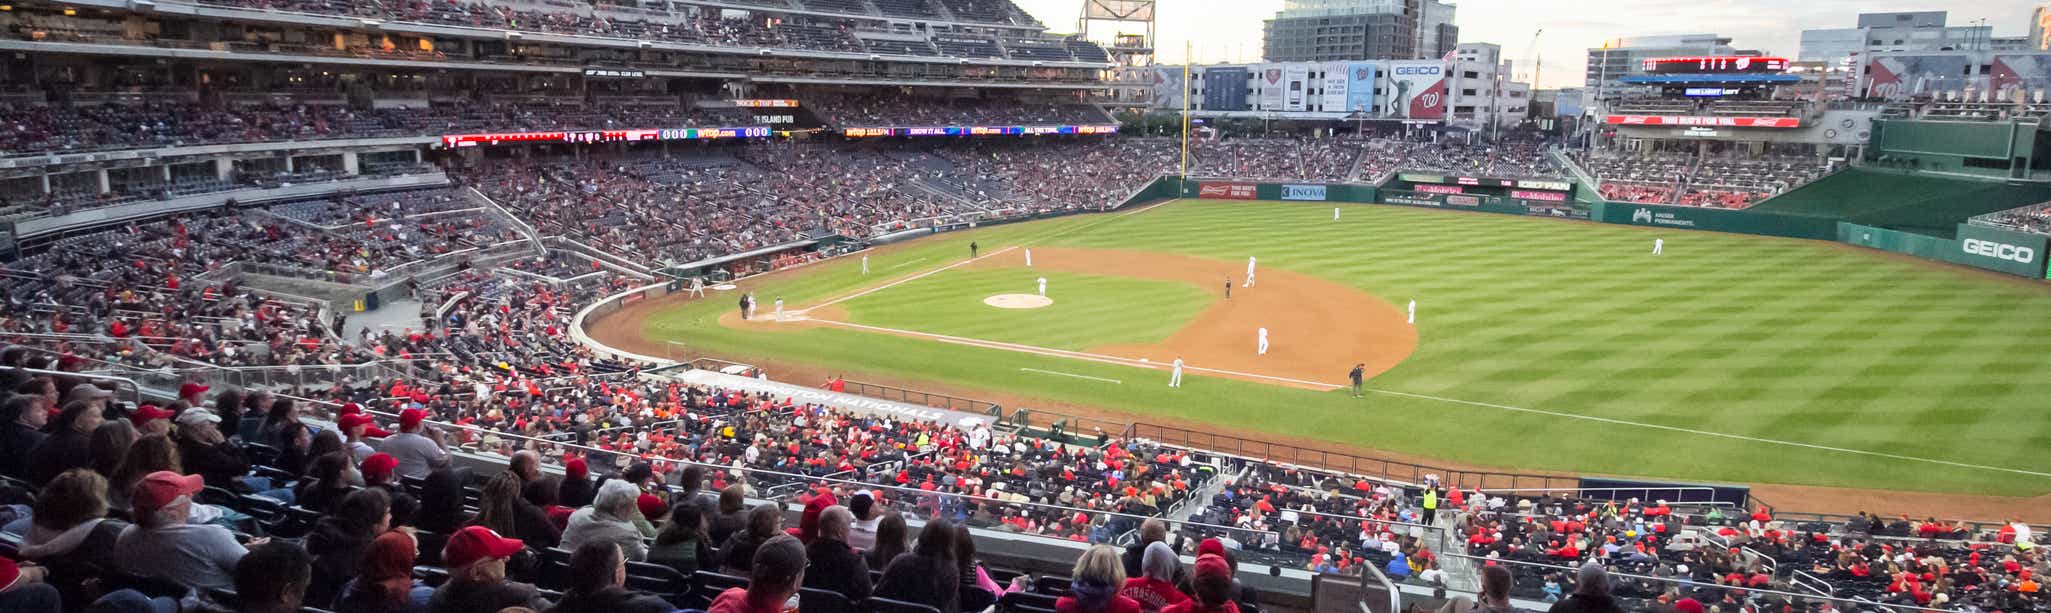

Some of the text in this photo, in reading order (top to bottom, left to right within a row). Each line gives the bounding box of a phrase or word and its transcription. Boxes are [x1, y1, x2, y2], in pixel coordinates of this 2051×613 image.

[1395, 66, 1440, 75] GEICO
[1422, 91, 1440, 108] W
[761, 115, 782, 124] ISLAND
[782, 115, 794, 123] PUB
[1292, 188, 1325, 197] INOVA
[1963, 238, 2034, 264] GEICO
[834, 396, 945, 420] NATIONALS
